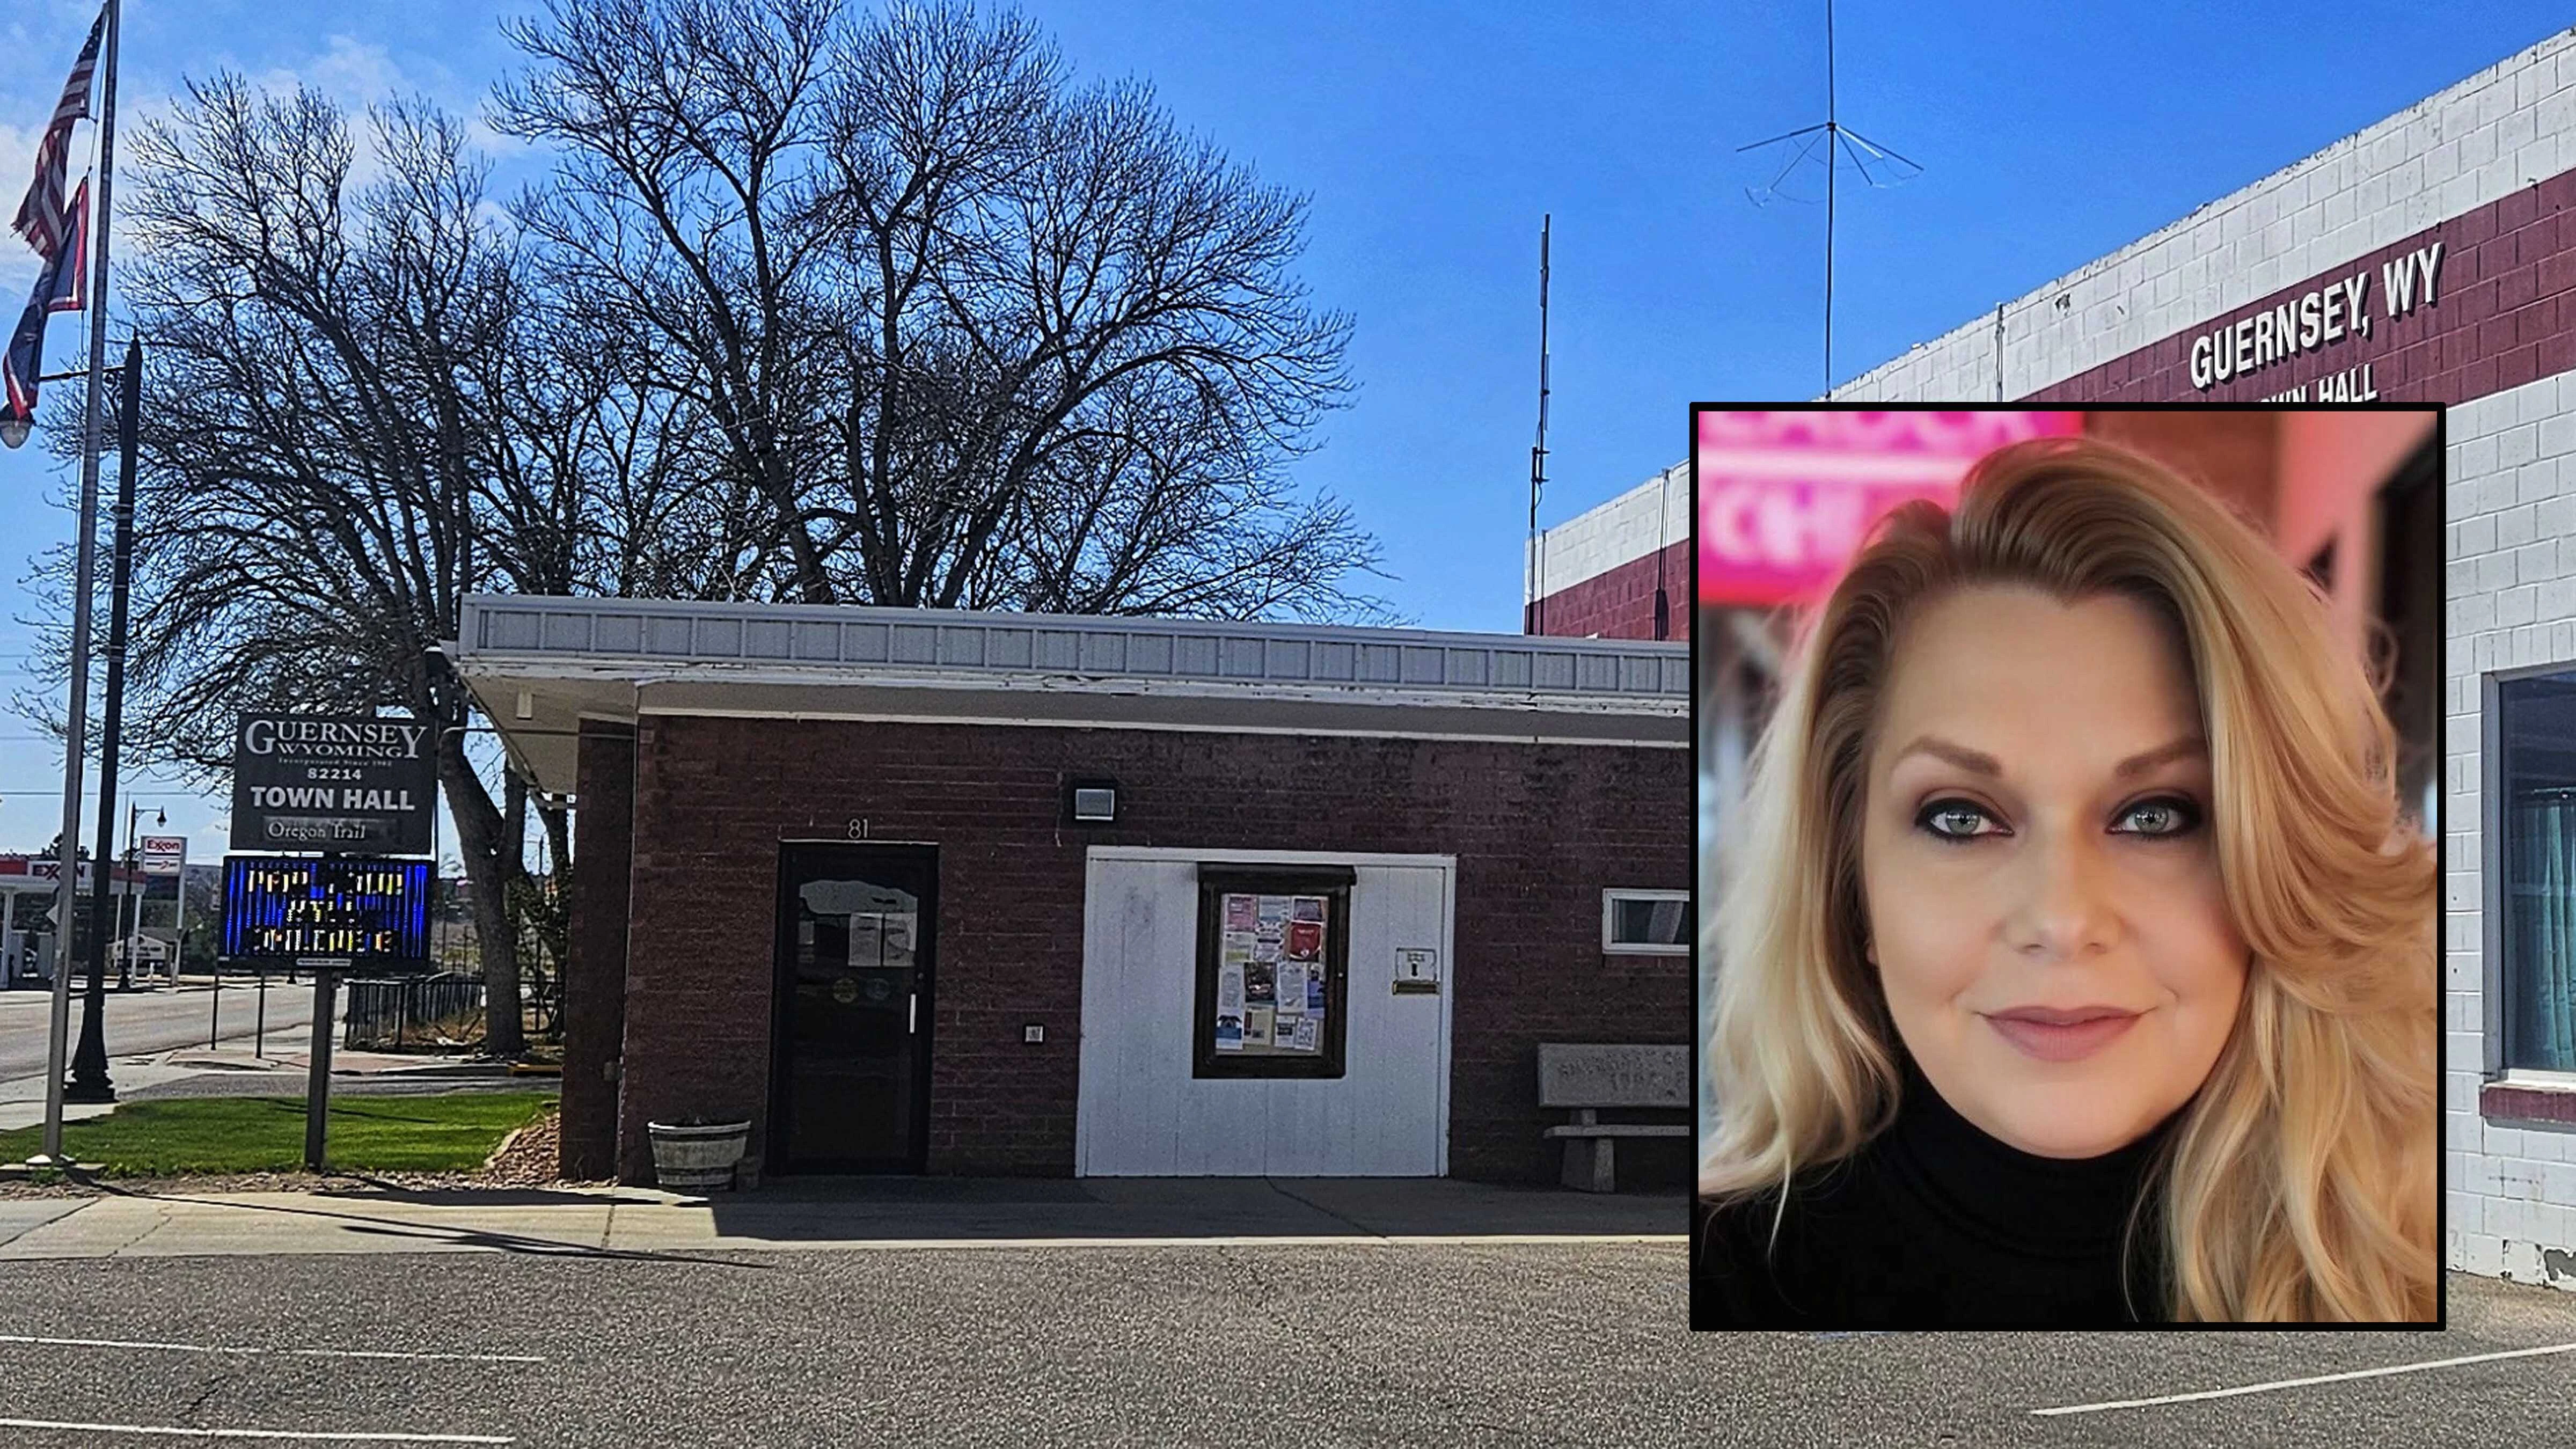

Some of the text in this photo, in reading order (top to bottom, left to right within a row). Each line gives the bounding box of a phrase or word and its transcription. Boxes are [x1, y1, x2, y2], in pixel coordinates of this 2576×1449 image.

[2190, 242, 2444, 390] GUERNSEY, WY
[2318, 363, 2377, 402] HALL
[245, 720, 427, 759] GUERNSEY
[277, 743, 402, 758] WYOMING
[308, 767, 362, 780] 82214
[250, 786, 415, 811] TOWN HALL
[268, 821, 366, 841] Oregon Trail
[848, 819, 868, 839] 81
[148, 840, 180, 852] Exxon
